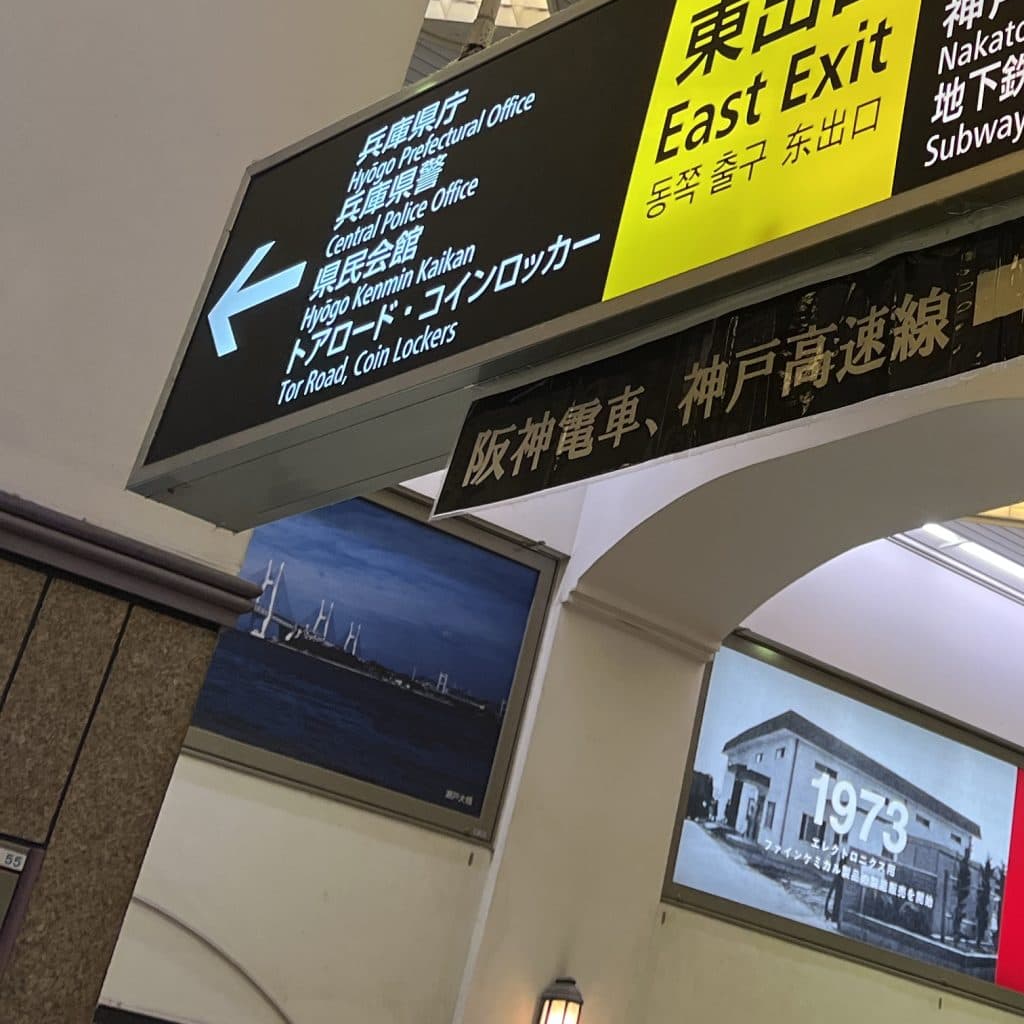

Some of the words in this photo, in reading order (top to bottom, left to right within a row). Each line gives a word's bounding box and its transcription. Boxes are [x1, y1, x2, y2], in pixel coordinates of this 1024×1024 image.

[356, 89, 469, 164] 兵庫県庁
[399, 109, 486, 168] Prefectural
[486, 92, 535, 127] Office
[654, 70, 767, 164] East
[780, 20, 893, 112] Exit
[781, 96, 882, 165] 东出口
[325, 214, 381, 258] Central
[381, 199, 427, 235] Police
[431, 177, 478, 212] Office
[333, 154, 447, 230] 兵庫県警
[646, 165, 702, 218] 동쪽
[710, 141, 769, 196] 출구
[309, 224, 424, 301] 県民会館
[352, 267, 413, 310] Kenmin
[417, 243, 476, 284] Kaikan
[286, 232, 601, 374] トアロード・コインロッカー
[278, 379, 303, 405] Tor
[304, 356, 348, 395] Road,
[354, 343, 389, 376] Coin
[393, 321, 458, 362] Lockers
[461, 287, 953, 488] 阪神電車、神戸高速線
[811, 773, 909, 854] 1973
